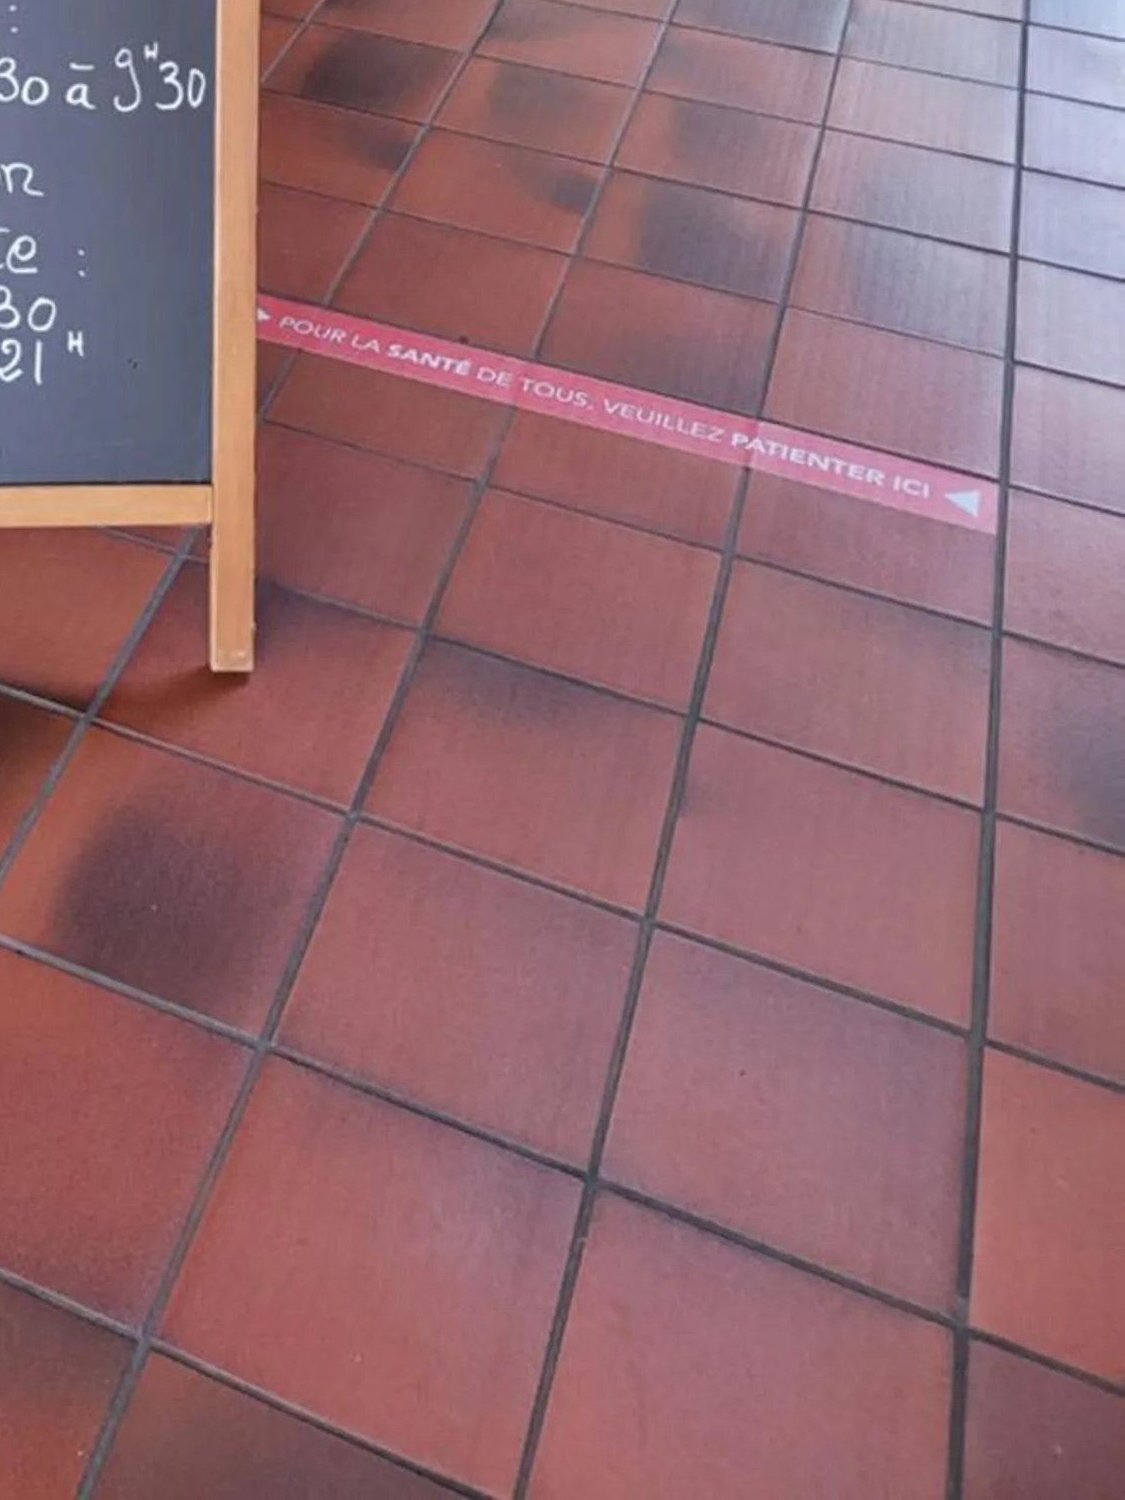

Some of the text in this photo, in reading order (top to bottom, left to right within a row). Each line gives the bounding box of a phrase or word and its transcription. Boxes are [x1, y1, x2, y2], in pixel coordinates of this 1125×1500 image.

[279, 314, 349, 346] POUR
[351, 331, 382, 354] LA
[387, 342, 473, 377] SANTÉ
[476, 365, 512, 389] DE
[603, 396, 725, 444] VEUILLEZ
[730, 430, 887, 488] PATIENTER
[892, 471, 932, 500] ICI
